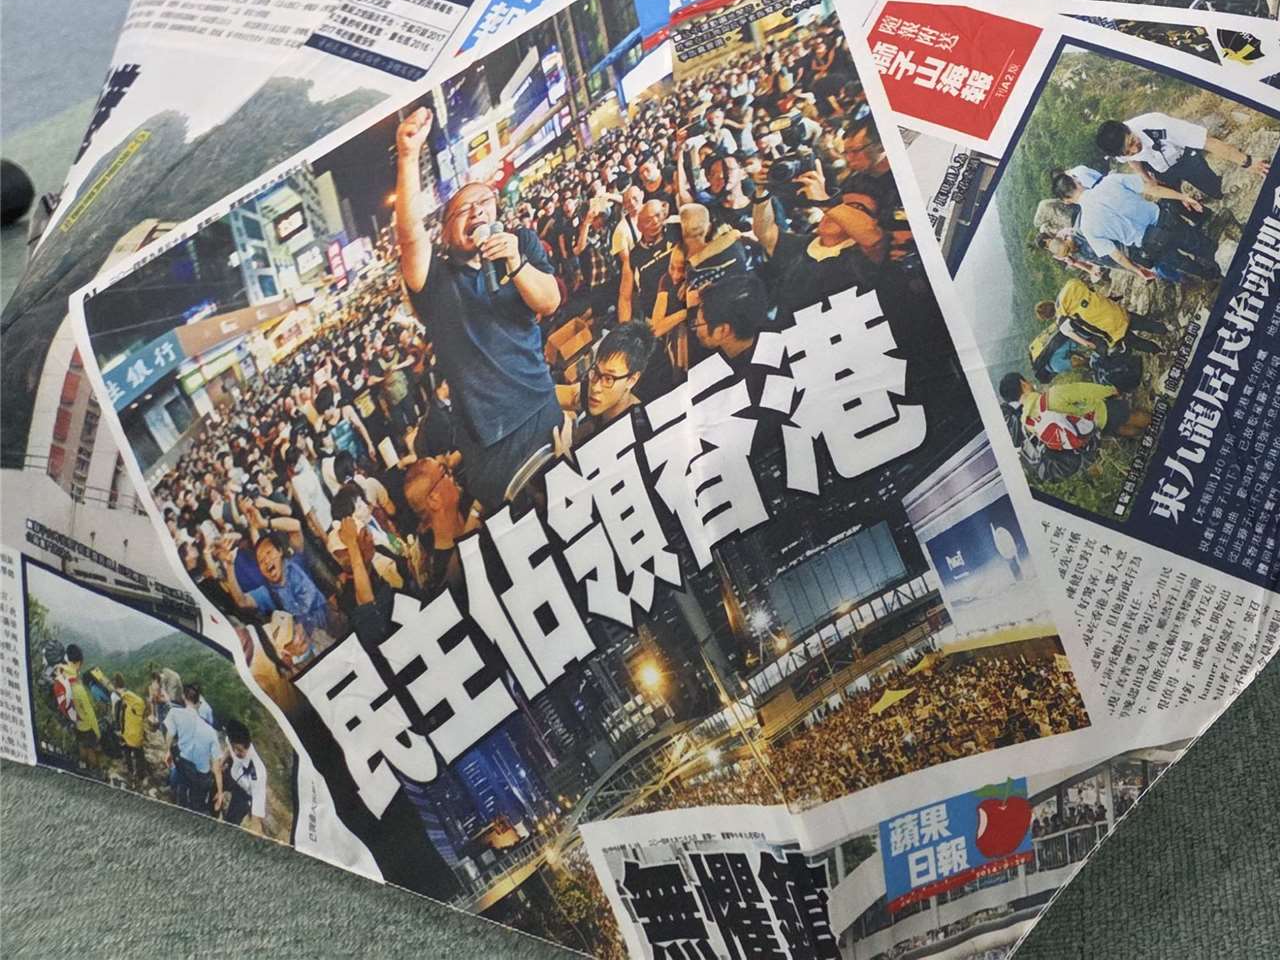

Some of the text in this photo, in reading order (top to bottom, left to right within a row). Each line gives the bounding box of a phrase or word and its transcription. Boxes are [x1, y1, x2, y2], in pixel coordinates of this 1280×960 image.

[878, 12, 961, 54] 隨報附送
[293, 288, 926, 820] 民主佔領香港
[888, 803, 951, 857] 蘋果
[906, 836, 971, 889] 日報
